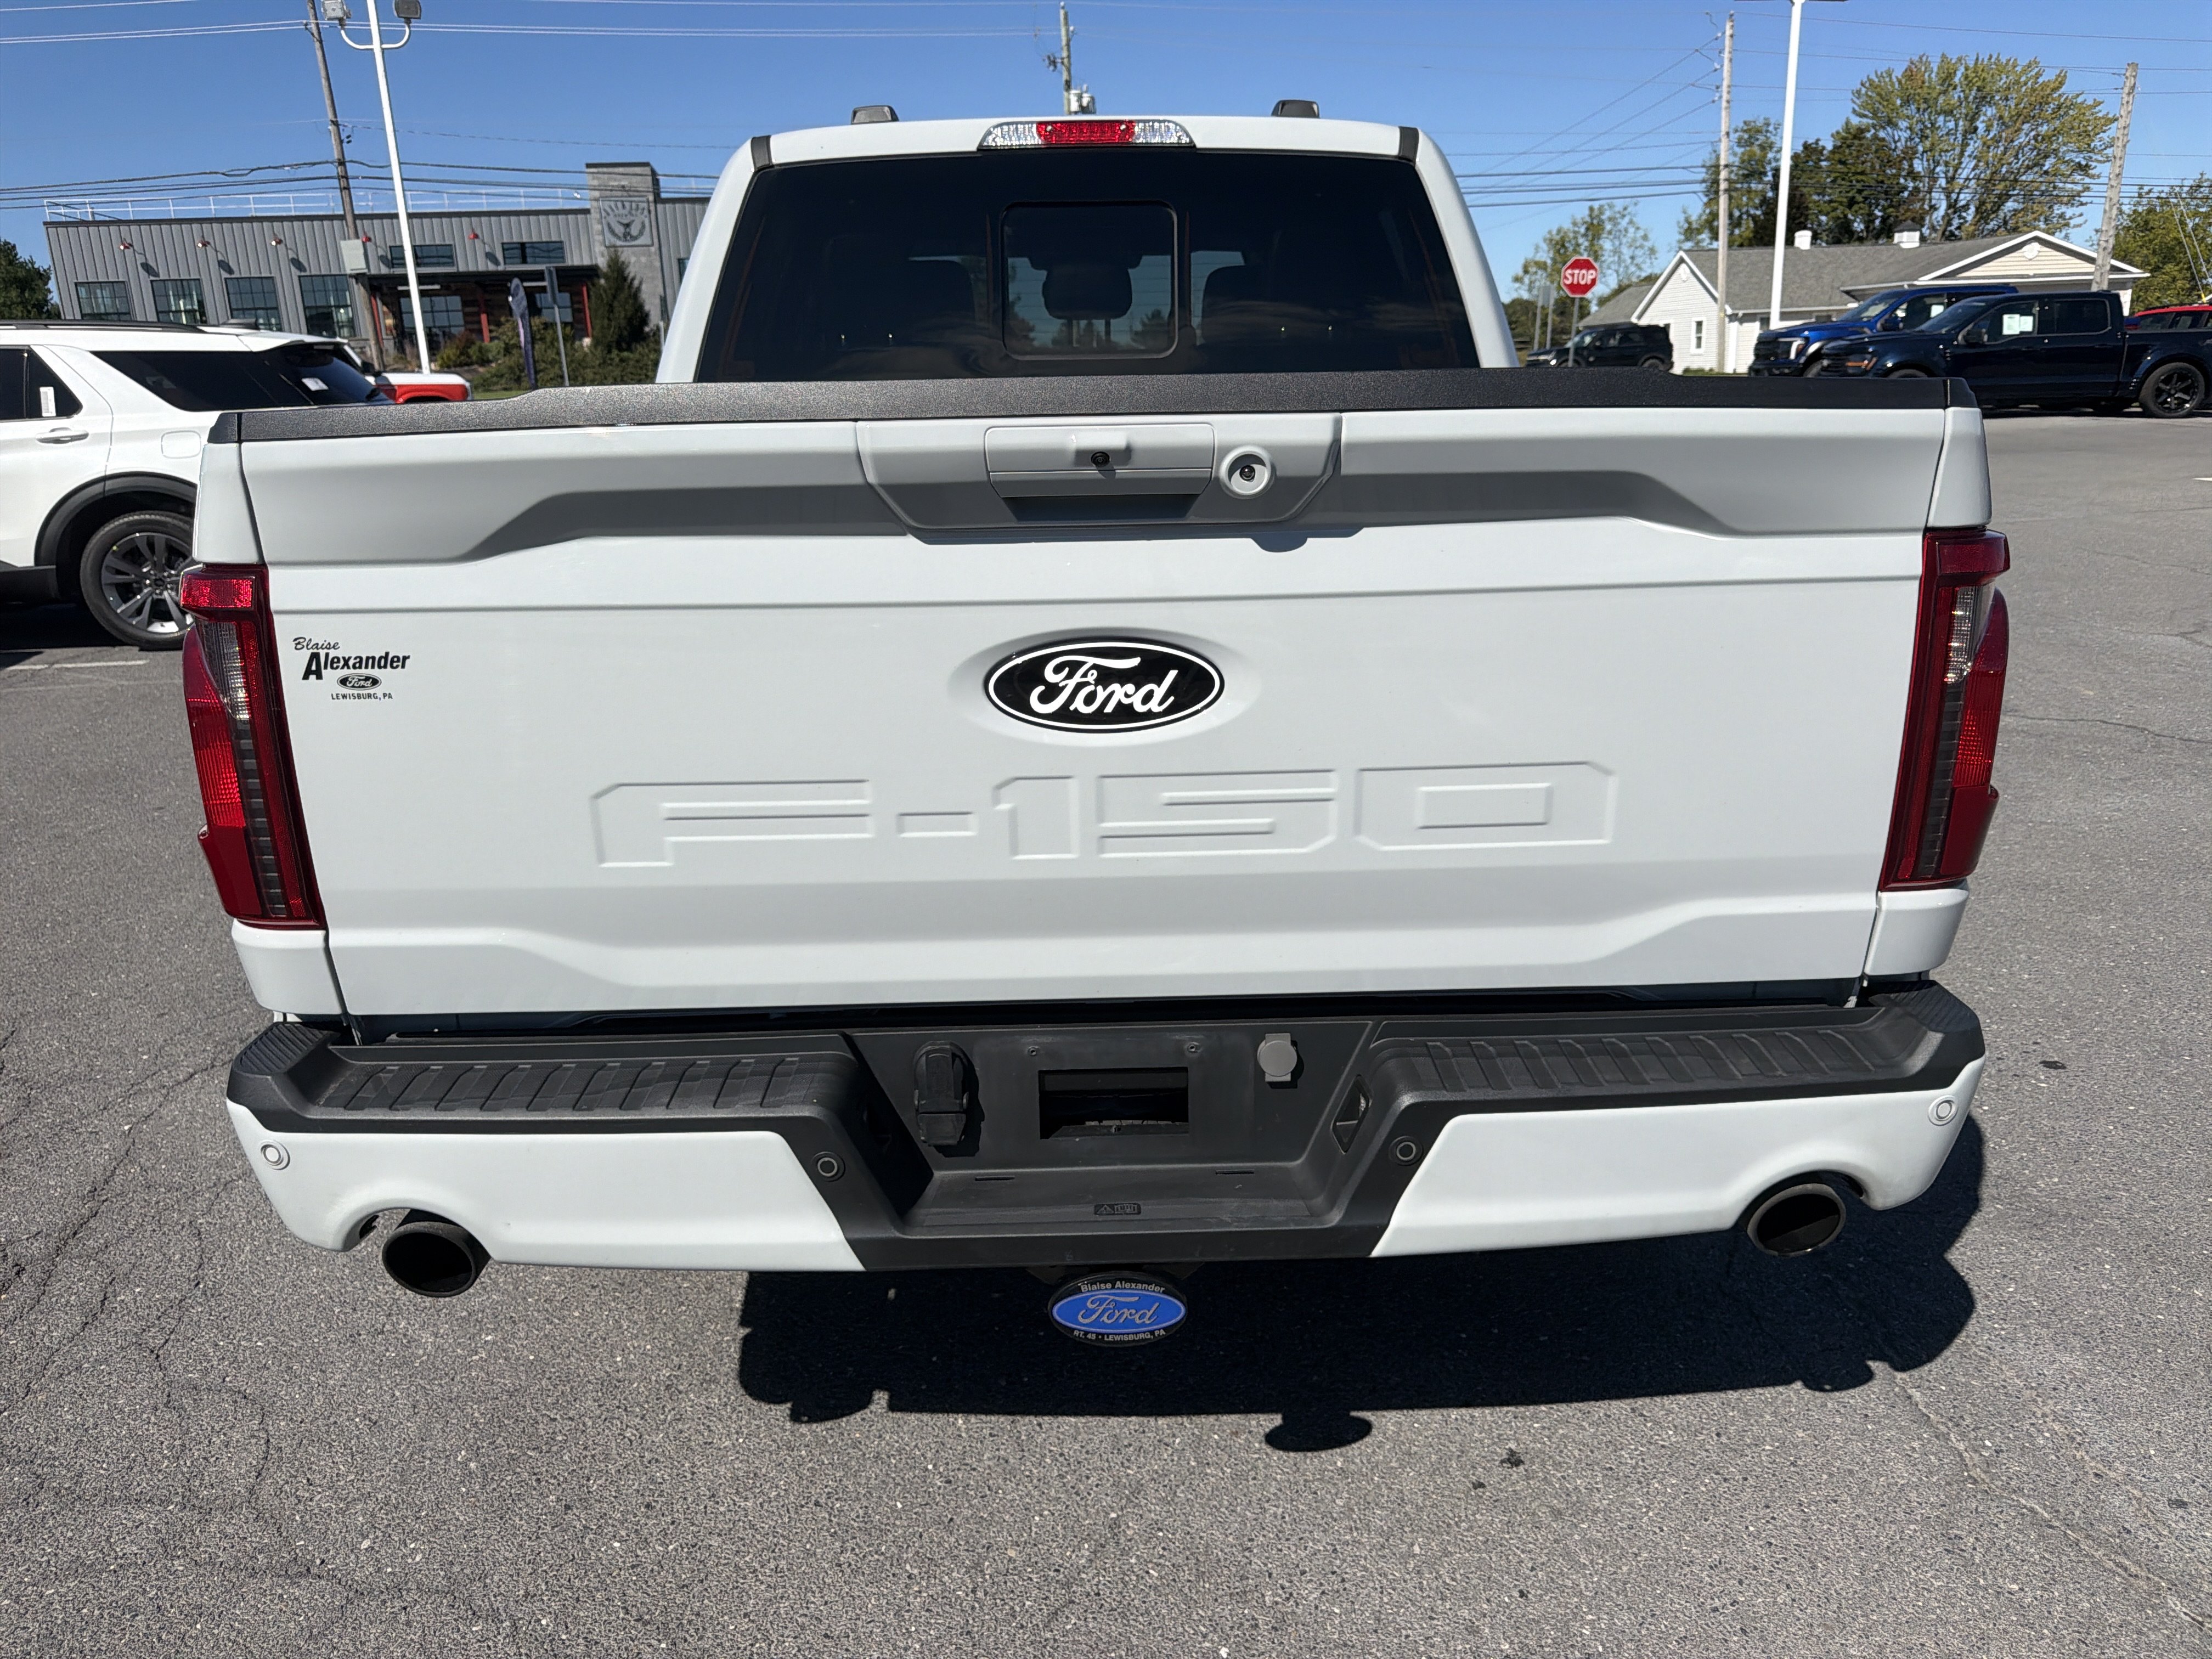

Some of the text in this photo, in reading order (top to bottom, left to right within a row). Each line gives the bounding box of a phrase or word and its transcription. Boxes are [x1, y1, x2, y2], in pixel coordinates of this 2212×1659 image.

[1564, 269, 1596, 285] STOP
[292, 636, 340, 651] Blaise
[302, 651, 410, 680] Alexander
[346, 675, 373, 687] Ford
[1029, 655, 1178, 714] Ford
[331, 692, 381, 701] LEWISBURG,
[591, 761, 1616, 868] F-150
[1080, 1280, 1165, 1294] Blaise Alexander
[1077, 1294, 1160, 1324] Ford
[1073, 1330, 1085, 1339] RT.
[1104, 1331, 1153, 1341] LEWISBURG,
[1154, 1328, 1166, 1337] PA
